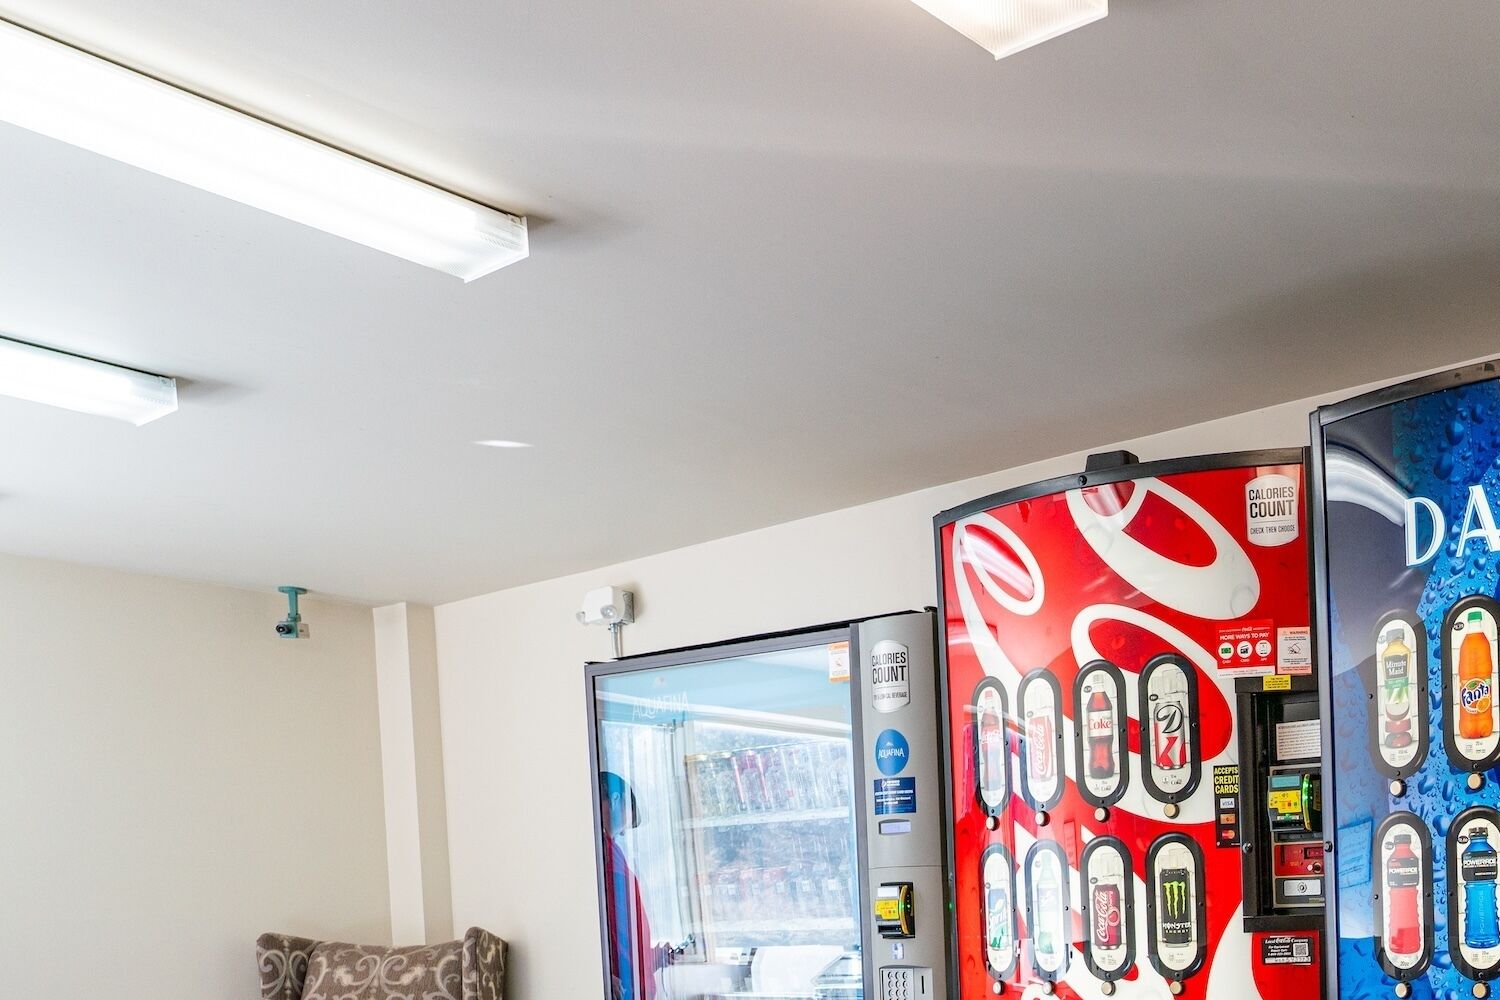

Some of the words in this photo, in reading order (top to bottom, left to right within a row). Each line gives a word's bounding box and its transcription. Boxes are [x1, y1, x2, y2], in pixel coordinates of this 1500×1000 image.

[1249, 486, 1294, 501] CALORIES
[1250, 499, 1295, 518] COUNT
[1250, 526, 1265, 535] CHECK
[1266, 525, 1278, 533] THEN
[1278, 523, 1296, 532] CHOOSE
[872, 651, 906, 667] CALORIES
[872, 665, 907, 685] COUNT
[1089, 714, 1112, 731] Coke
[878, 747, 905, 760] AQUAFINA
[1214, 766, 1239, 775] ACCEPTS
[1214, 775, 1239, 785] CREDIT
[1215, 784, 1239, 794] CARDS
[1163, 921, 1192, 930] MONSTER
